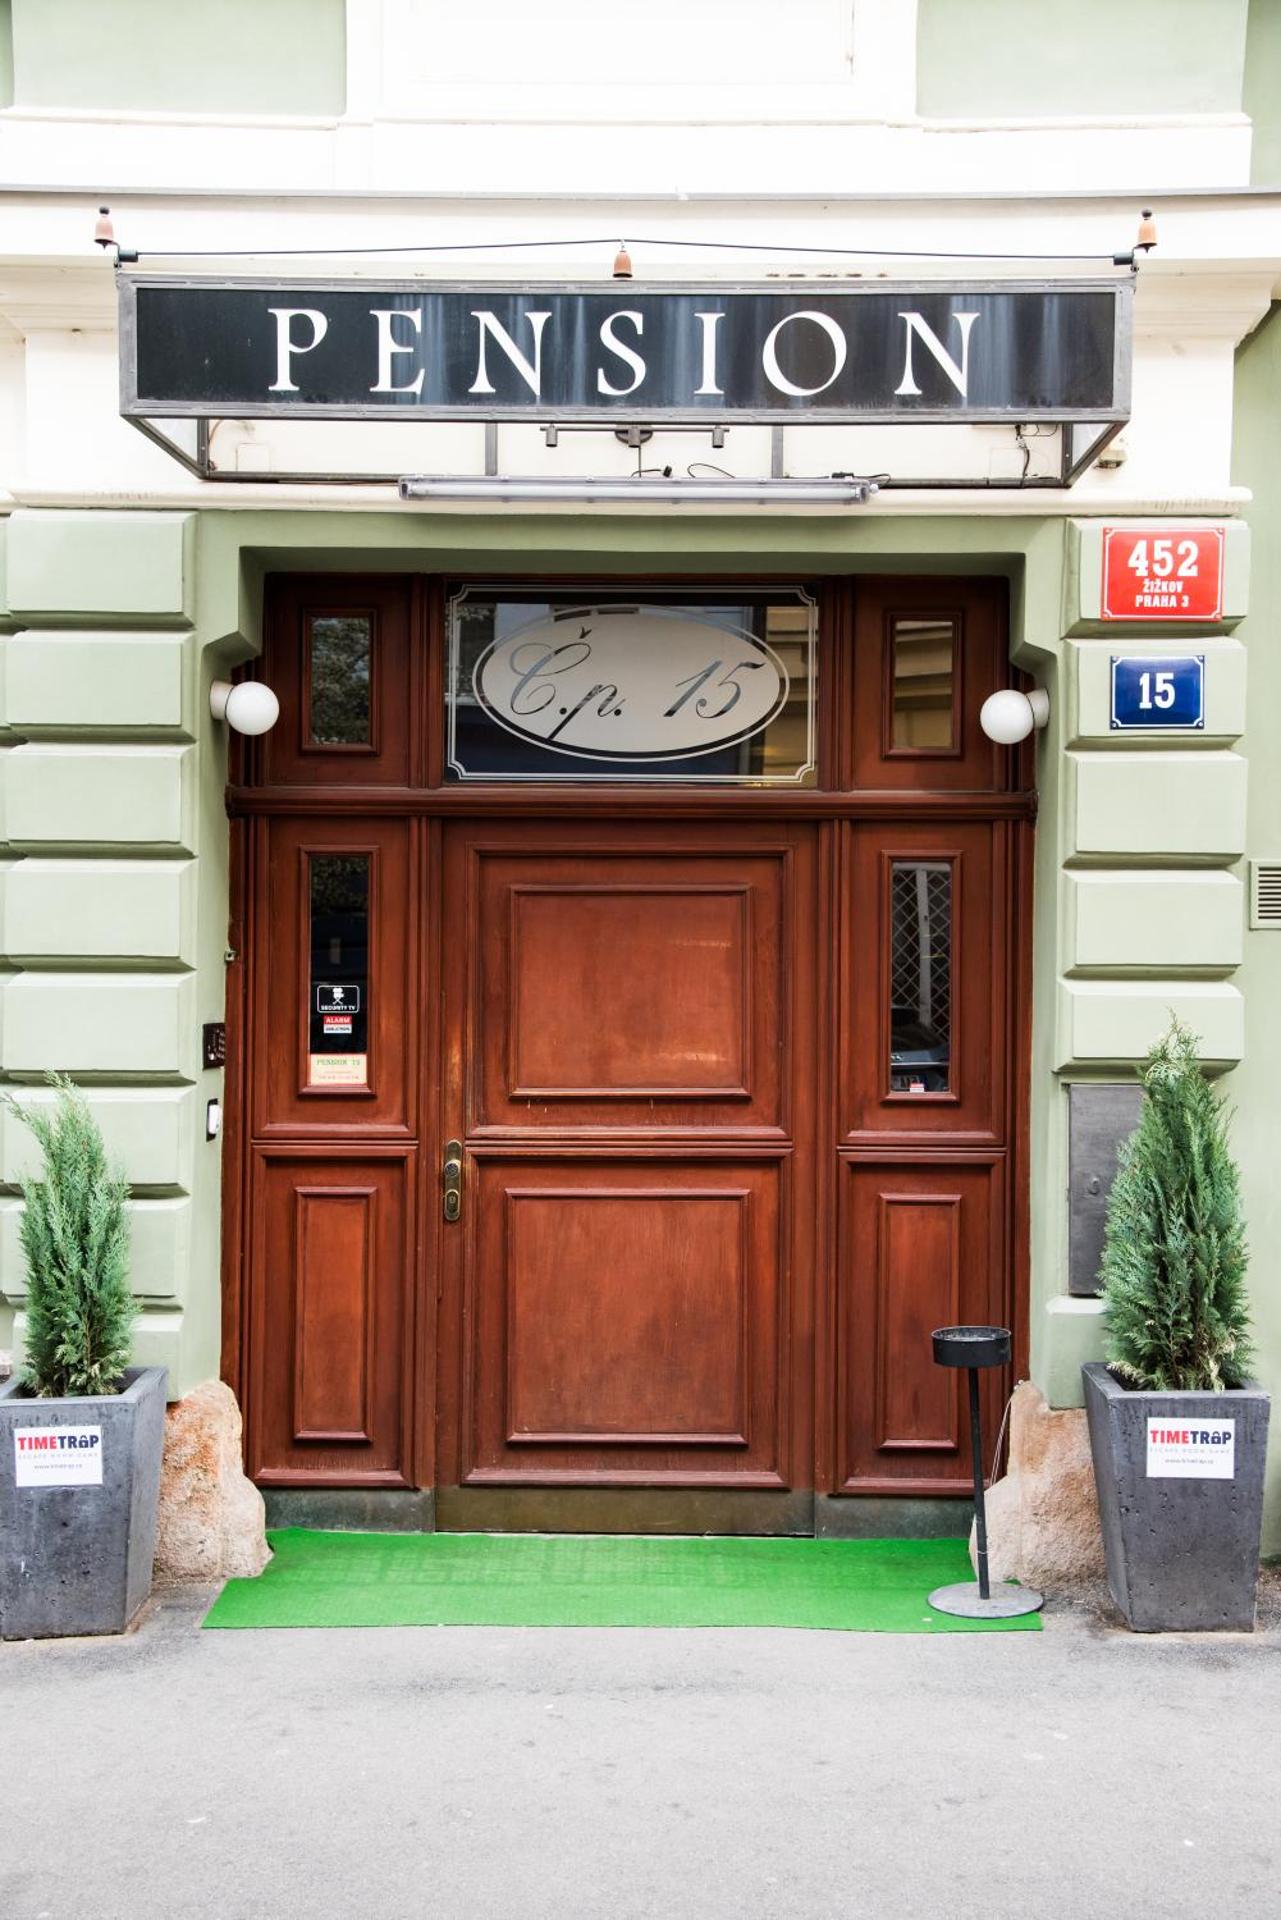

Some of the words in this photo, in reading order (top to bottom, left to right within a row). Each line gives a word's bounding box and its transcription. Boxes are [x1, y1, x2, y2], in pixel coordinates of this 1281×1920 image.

[267, 307, 980, 398] PENSION
[1128, 540, 1200, 577] 452
[1143, 578, 1184, 593] ŽIŽKOV
[1135, 595, 1177, 608] PRAHA
[1181, 595, 1190, 608] 3
[663, 660, 767, 719] 15
[1139, 672, 1176, 709] 15
[17, 1434, 100, 1450] TIMETRAP
[1150, 1430, 1232, 1445] TIMETRAP
